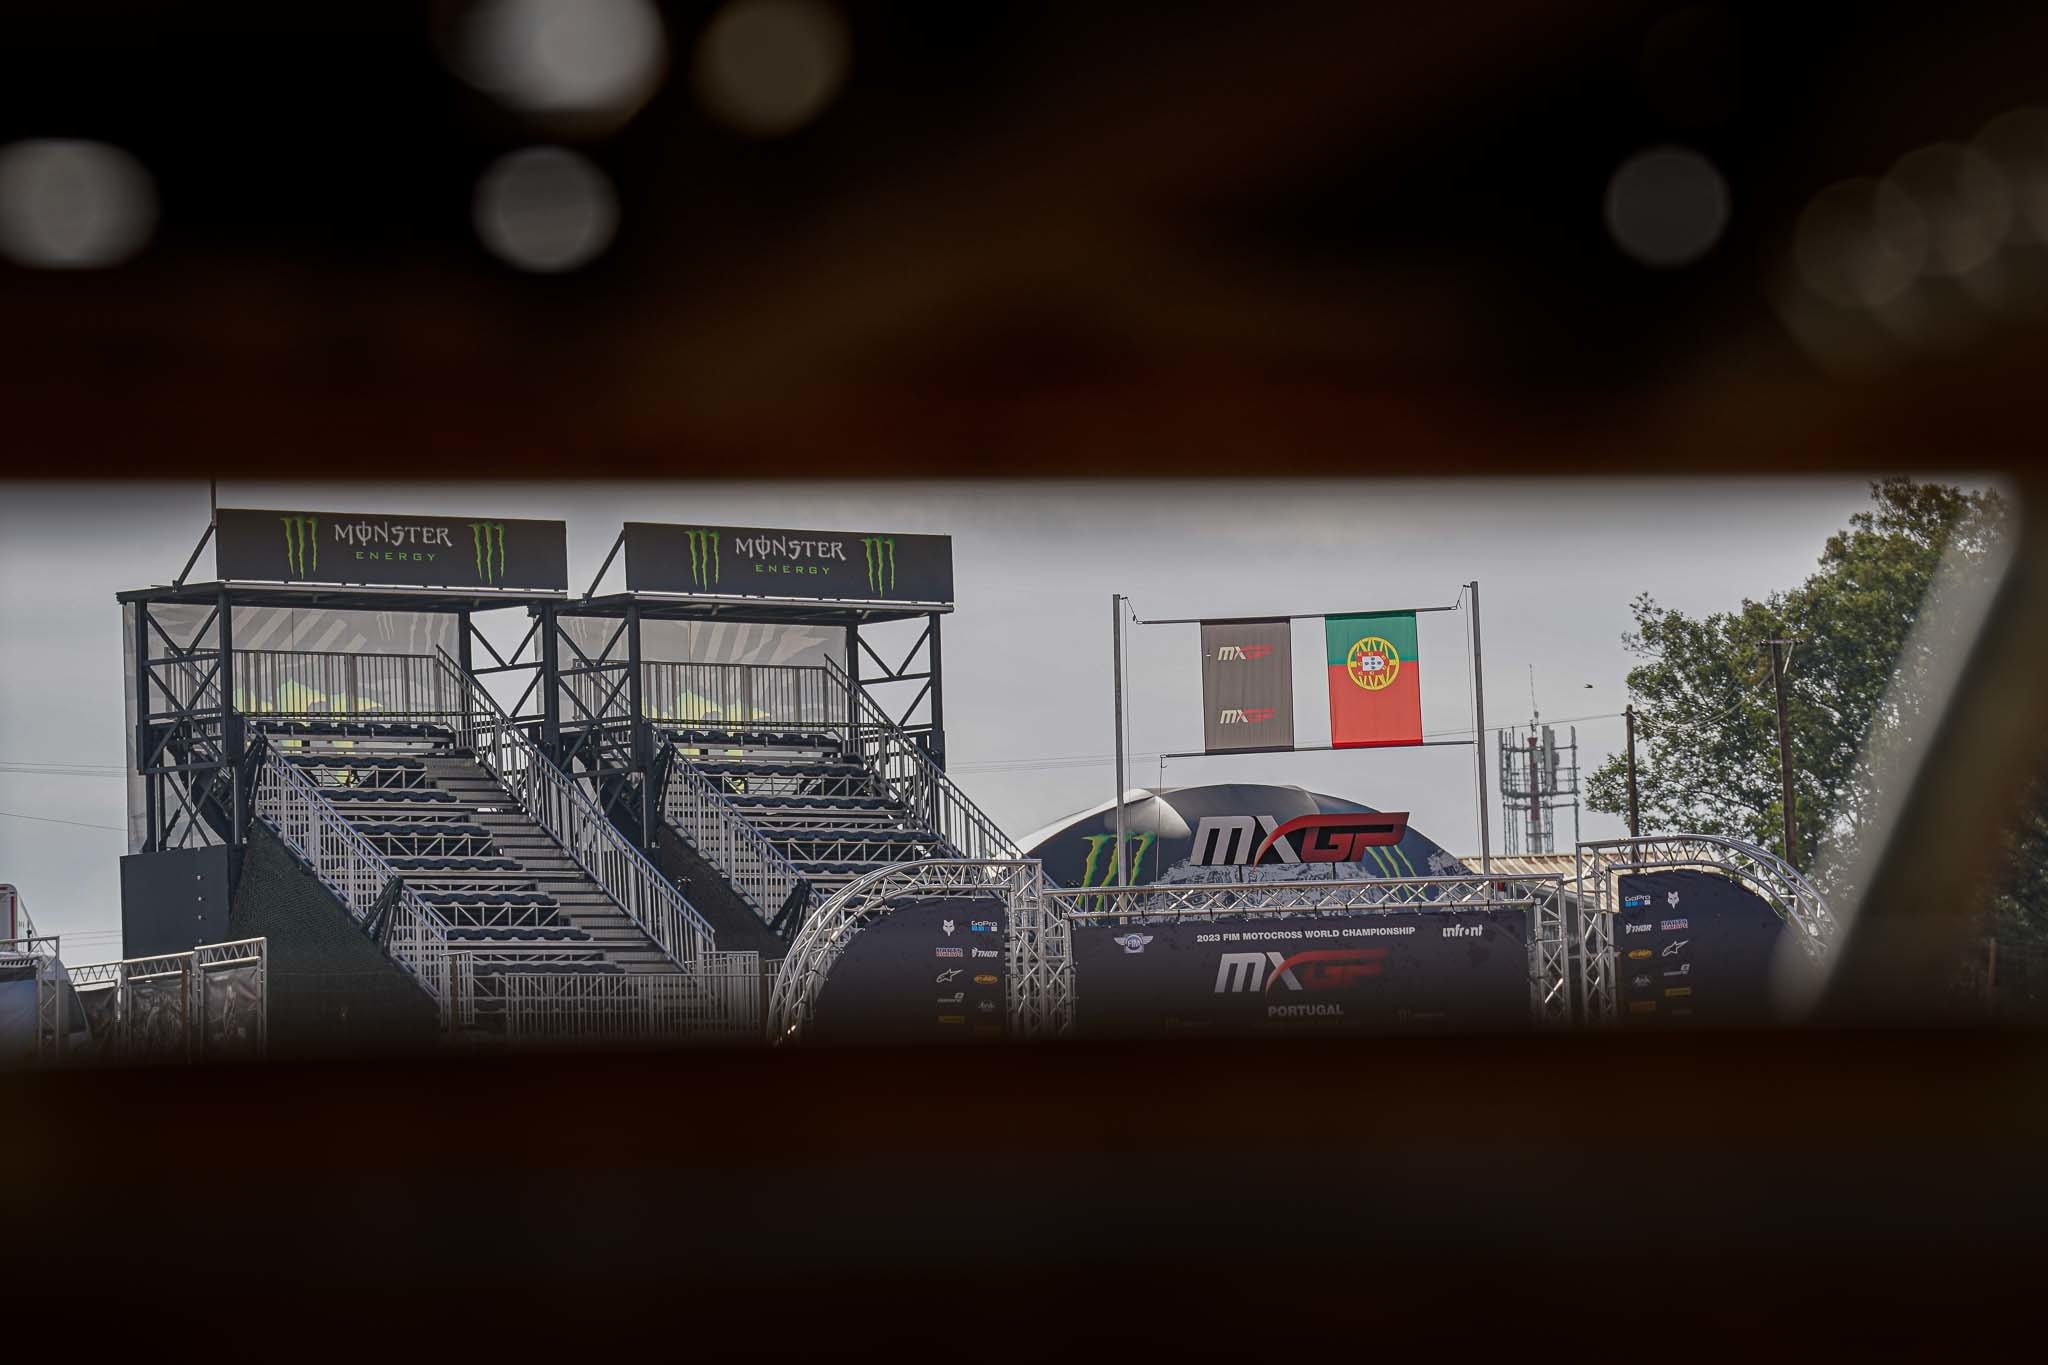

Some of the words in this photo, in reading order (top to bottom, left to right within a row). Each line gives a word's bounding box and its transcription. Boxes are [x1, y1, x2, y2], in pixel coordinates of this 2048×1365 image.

[333, 520, 453, 547] MONSTER
[355, 551, 437, 561] ENERGY
[735, 534, 846, 561] MONSTER
[755, 564, 830, 575] ENERGY
[1190, 812, 1409, 867] MXGP
[1196, 933, 1221, 943] 2023
[1223, 932, 1240, 941] FIM
[1242, 930, 1303, 941] MOTOCROSS
[1305, 929, 1340, 939] WORLD
[1342, 926, 1416, 937] CHAMPIONSHIP
[1214, 950, 1388, 999] MXGP
[1267, 1004, 1343, 1017] PORTUGAL
